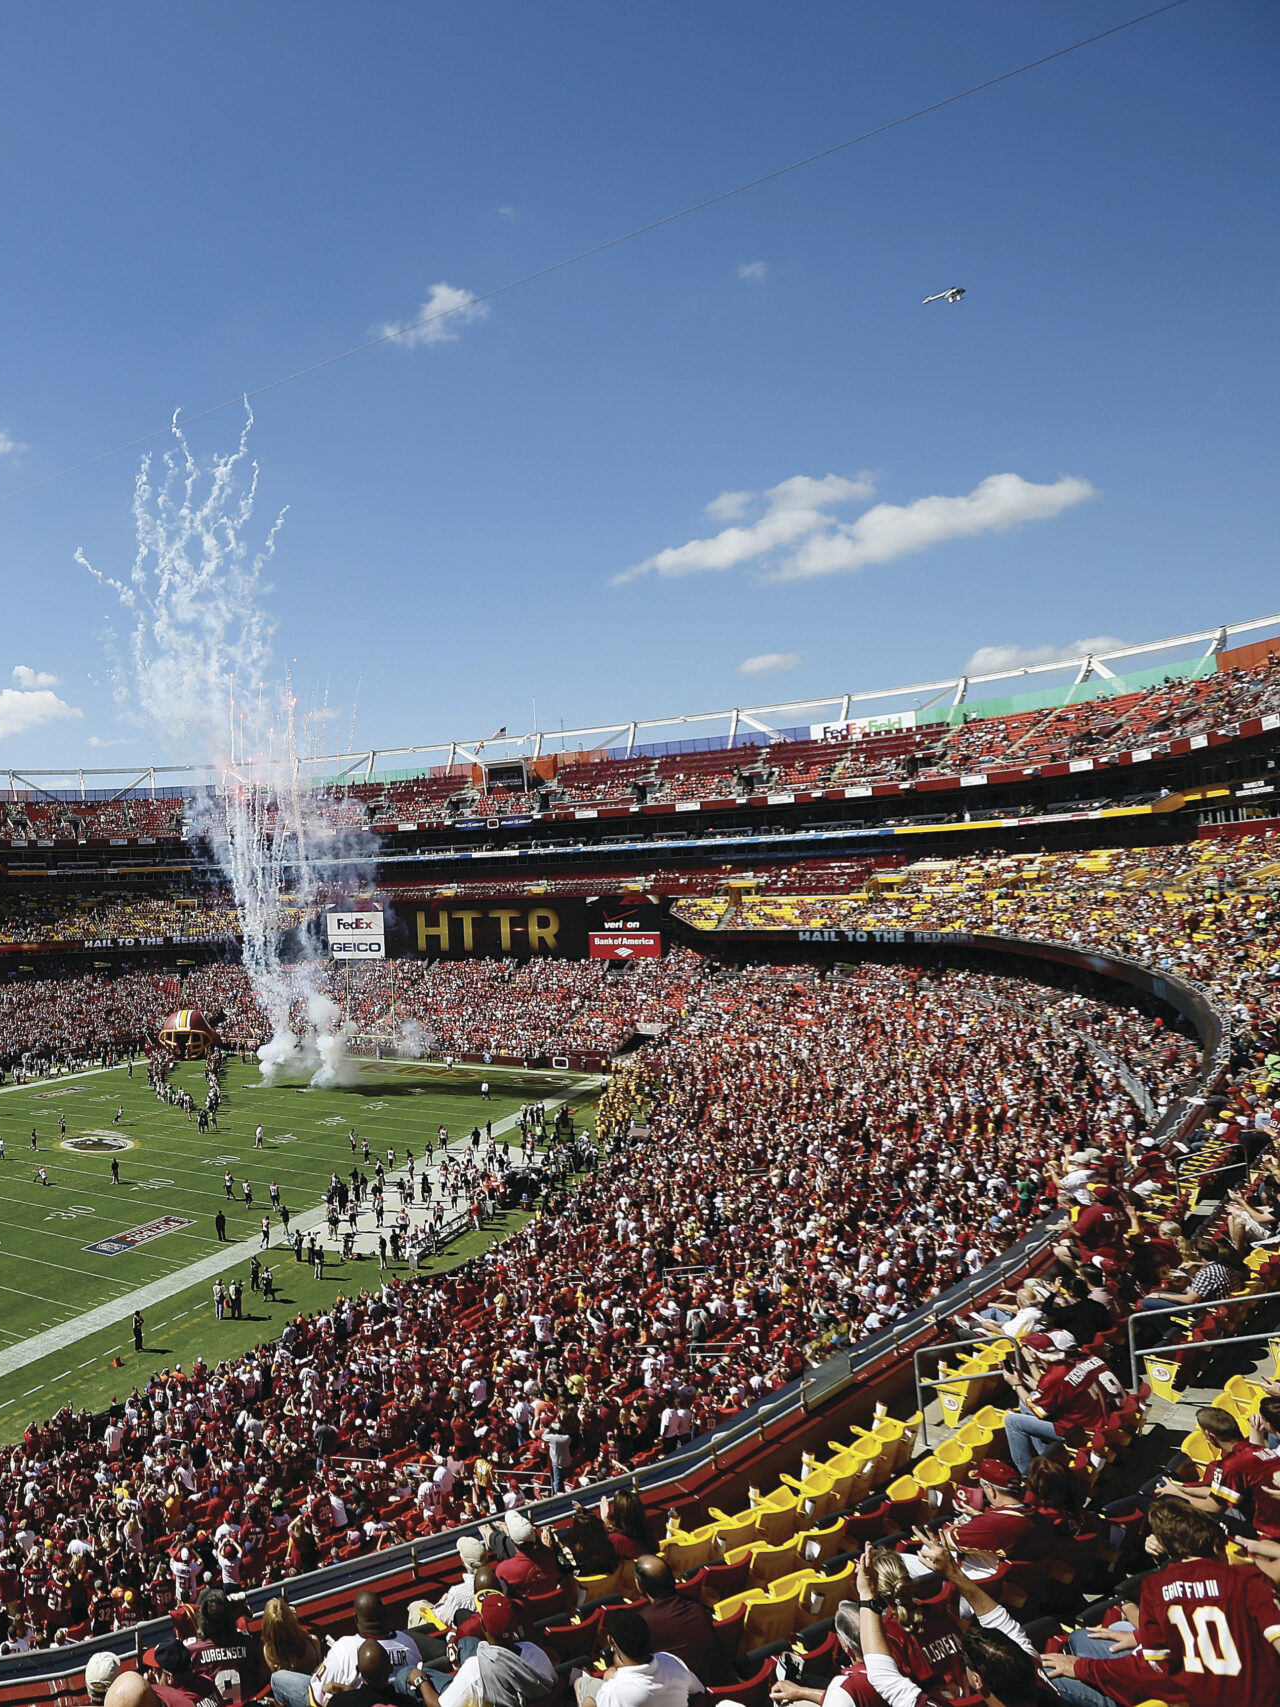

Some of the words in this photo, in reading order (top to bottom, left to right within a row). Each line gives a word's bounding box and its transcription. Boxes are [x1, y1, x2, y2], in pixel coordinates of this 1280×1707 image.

[336, 918, 373, 932] FedEx
[416, 909, 560, 952] HTTR
[603, 919, 640, 929] verizon
[84, 938, 114, 948] HAIL
[118, 938, 134, 947] TO
[139, 937, 164, 946] THE
[594, 937, 612, 946] Bank
[622, 937, 654, 946] America
[798, 931, 839, 942] HAIL
[845, 931, 867, 942] TO
[872, 931, 905, 942] THE
[331, 941, 382, 953] GEICO
[51, 1205, 96, 1220] 30
[248, 1534, 265, 1548] 77
[1162, 1581, 1205, 1601] GRIFFIN
[1205, 1579, 1219, 1597] III
[98, 1608, 111, 1621] 32
[1167, 1605, 1242, 1676] 10
[200, 1646, 247, 1664] JURGENSEN
[215, 1669, 242, 1704] 9
